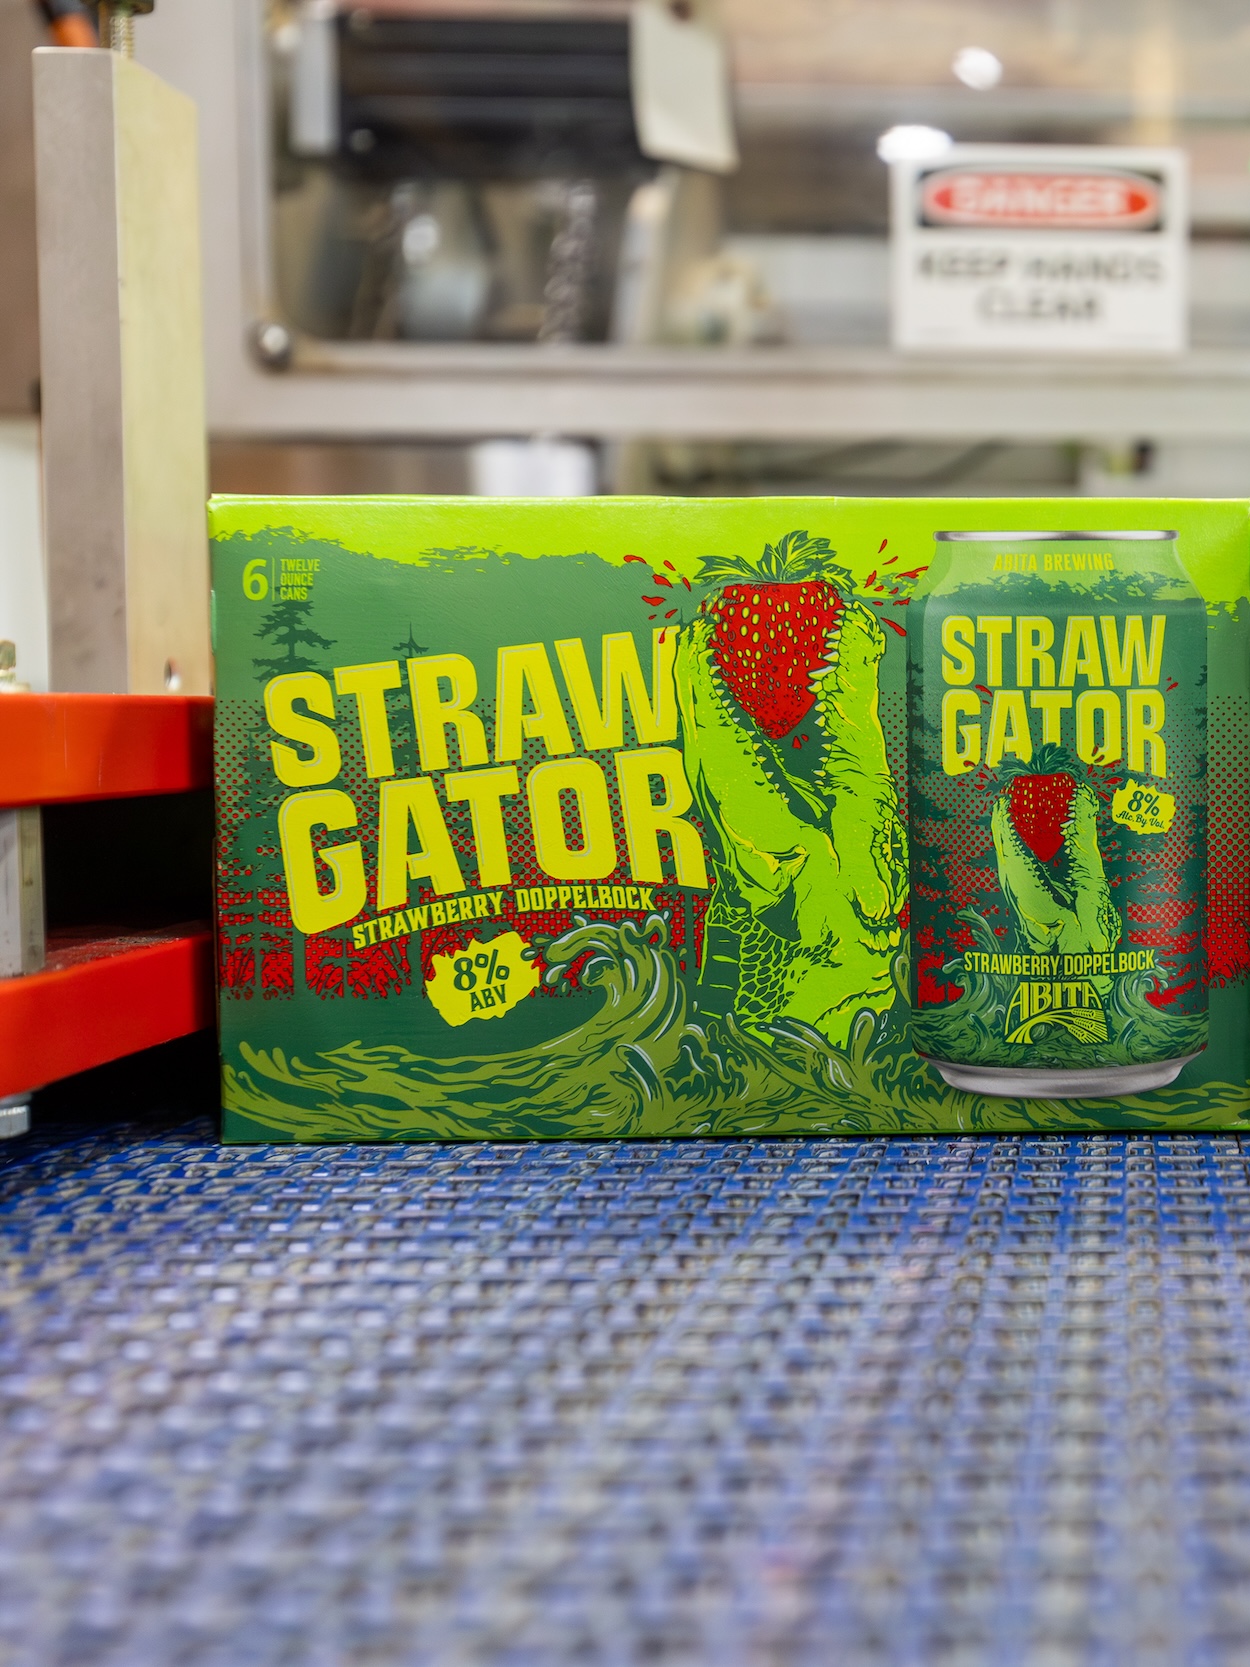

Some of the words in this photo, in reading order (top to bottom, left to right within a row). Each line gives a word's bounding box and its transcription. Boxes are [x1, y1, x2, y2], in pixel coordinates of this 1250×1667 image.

[950, 174, 1130, 220] DANGER
[918, 250, 1012, 281] KEEP
[1022, 251, 1166, 285] HANDS
[976, 287, 1104, 322] CLEAR
[280, 558, 320, 572] TWELVE
[993, 553, 1038, 571] ABITA
[1044, 552, 1115, 571] BREWING
[242, 558, 269, 601] 6
[280, 573, 314, 586] OUNCE
[280, 587, 308, 601] CANS
[942, 615, 1166, 687] STRAW
[263, 626, 681, 788] STRAW
[942, 688, 1167, 778] GATOR
[1116, 810, 1134, 822] Alc.
[1136, 814, 1147, 828] By
[1127, 790, 1160, 817] 8%
[277, 746, 708, 935] GATOR
[352, 891, 503, 950] STRAWBERRY
[516, 885, 657, 913] DOPPELBOCK
[453, 948, 511, 991] 8%
[964, 951, 1060, 975] STRAWBERRY
[1064, 949, 1155, 975] DOPPELBOCK
[470, 983, 508, 1013] ABV
[1004, 981, 1103, 1036] ABITA
